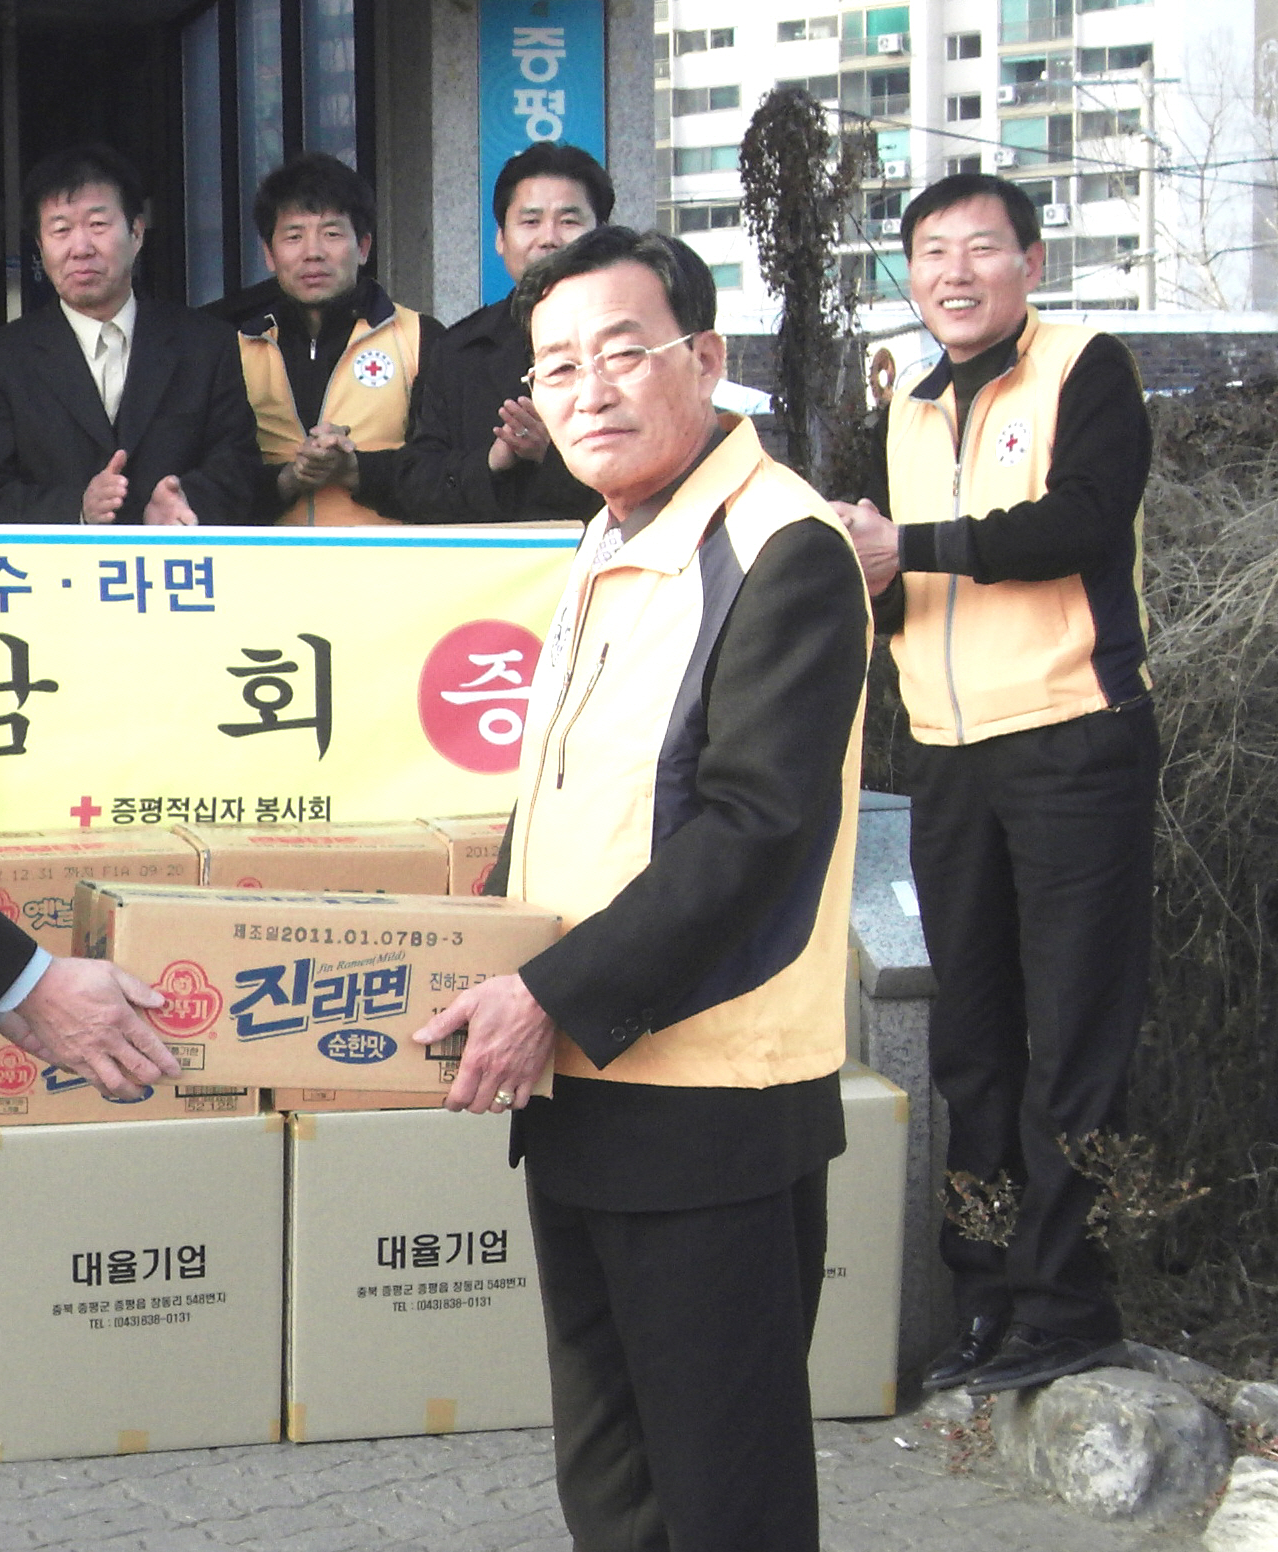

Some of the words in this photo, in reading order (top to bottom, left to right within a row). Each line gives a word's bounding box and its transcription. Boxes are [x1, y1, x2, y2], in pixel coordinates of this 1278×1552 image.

[98, 556, 216, 613] 라면
[217, 632, 332, 762] 회
[440, 649, 533, 746] 증
[110, 796, 245, 824] 증평적십자
[254, 795, 332, 823] 봉사회
[228, 957, 412, 1044] 진라면
[430, 972, 469, 991] 진하고
[158, 998, 209, 1021] 오뚜기
[327, 1033, 387, 1059] 순한맛
[72, 1244, 206, 1286] 대율기업
[377, 1229, 508, 1270] 대율기업
